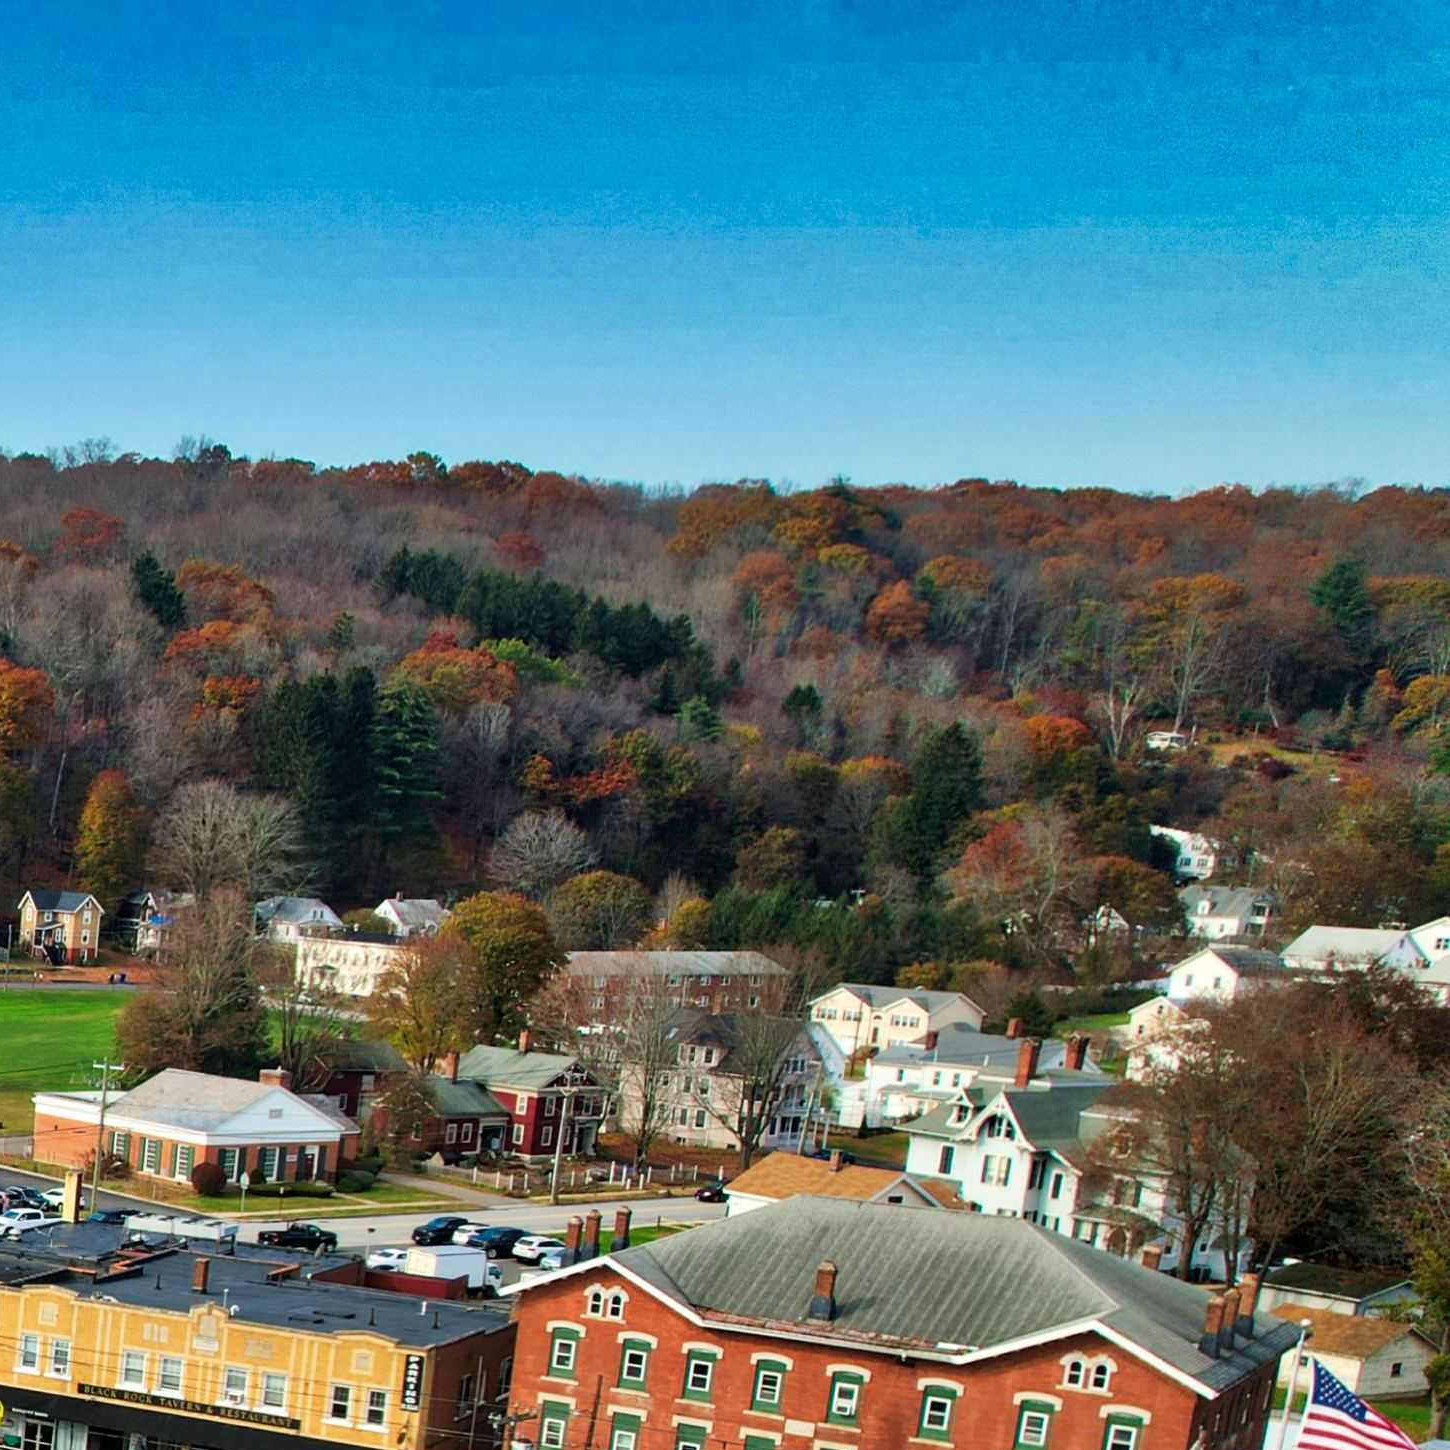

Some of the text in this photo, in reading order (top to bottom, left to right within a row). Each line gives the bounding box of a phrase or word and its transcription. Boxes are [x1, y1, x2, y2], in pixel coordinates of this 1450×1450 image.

[404, 1355, 420, 1405] PARKING
[83, 1386, 117, 1399] BLACK
[123, 1391, 152, 1404] ROCK
[159, 1397, 201, 1412] TAVERN
[220, 1408, 293, 1428] RESTAURANT
